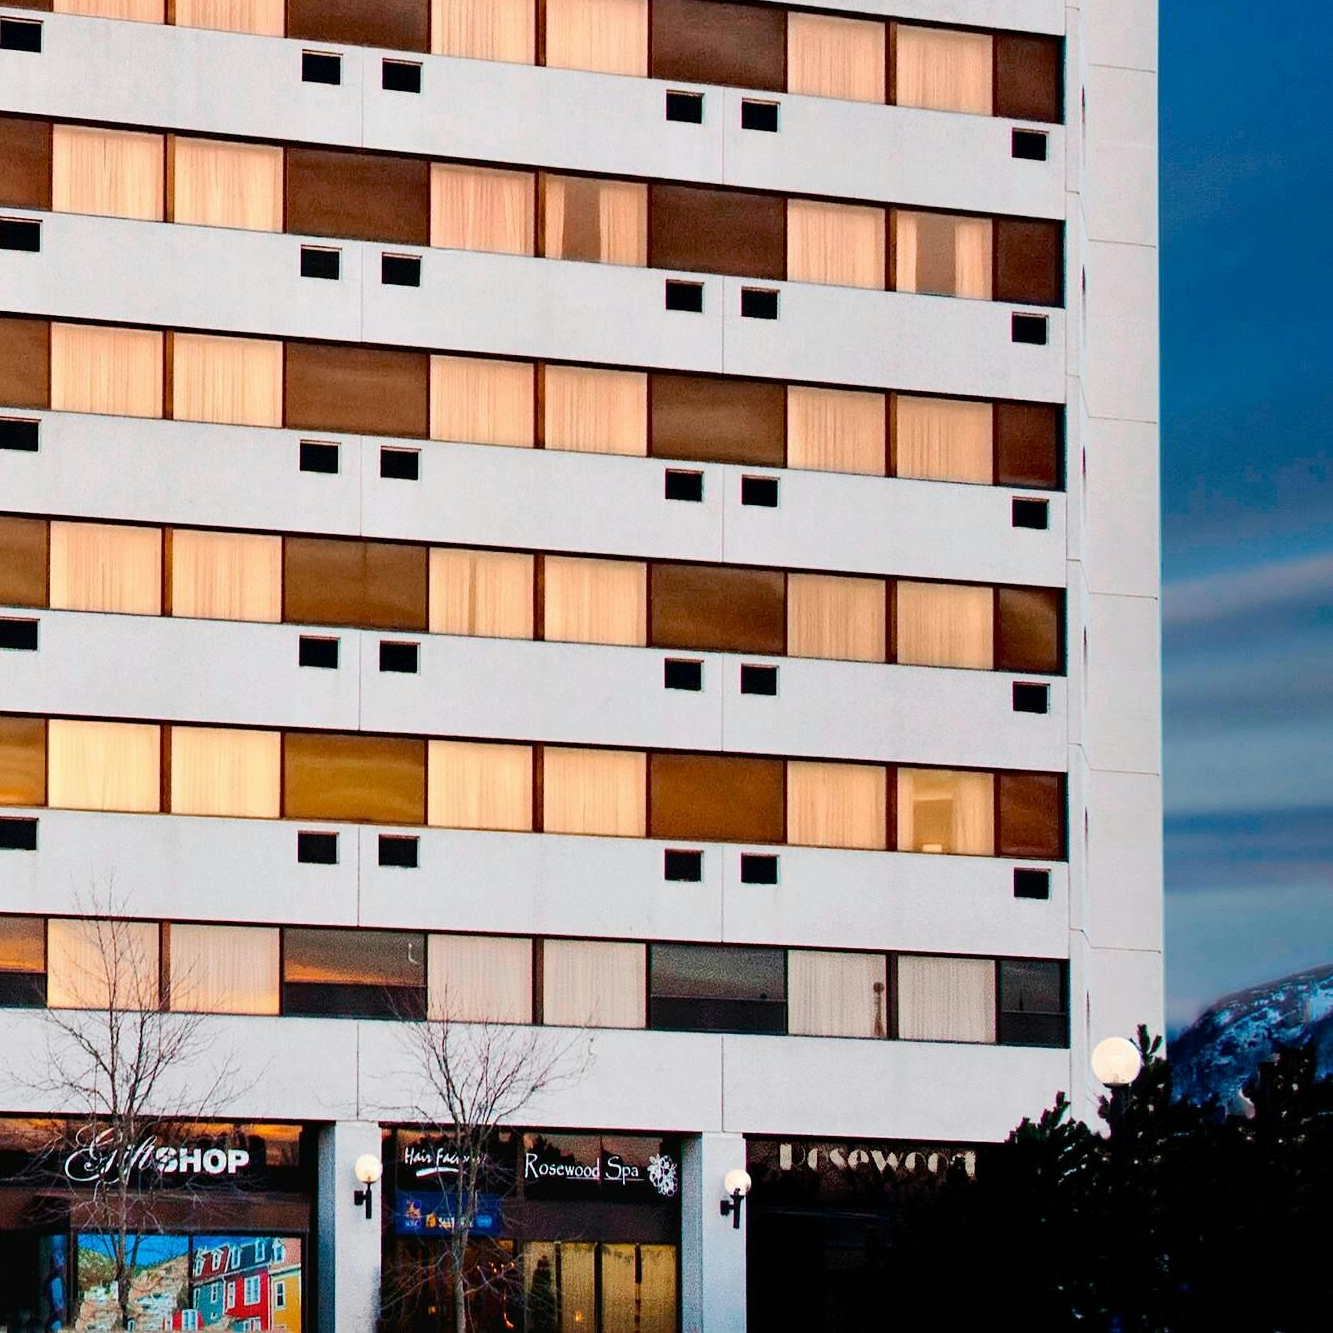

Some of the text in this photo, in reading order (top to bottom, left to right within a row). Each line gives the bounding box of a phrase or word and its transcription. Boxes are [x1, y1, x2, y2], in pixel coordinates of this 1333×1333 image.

[404, 1146, 431, 1165] Hair
[524, 1152, 640, 1185] Rosewood Spa
